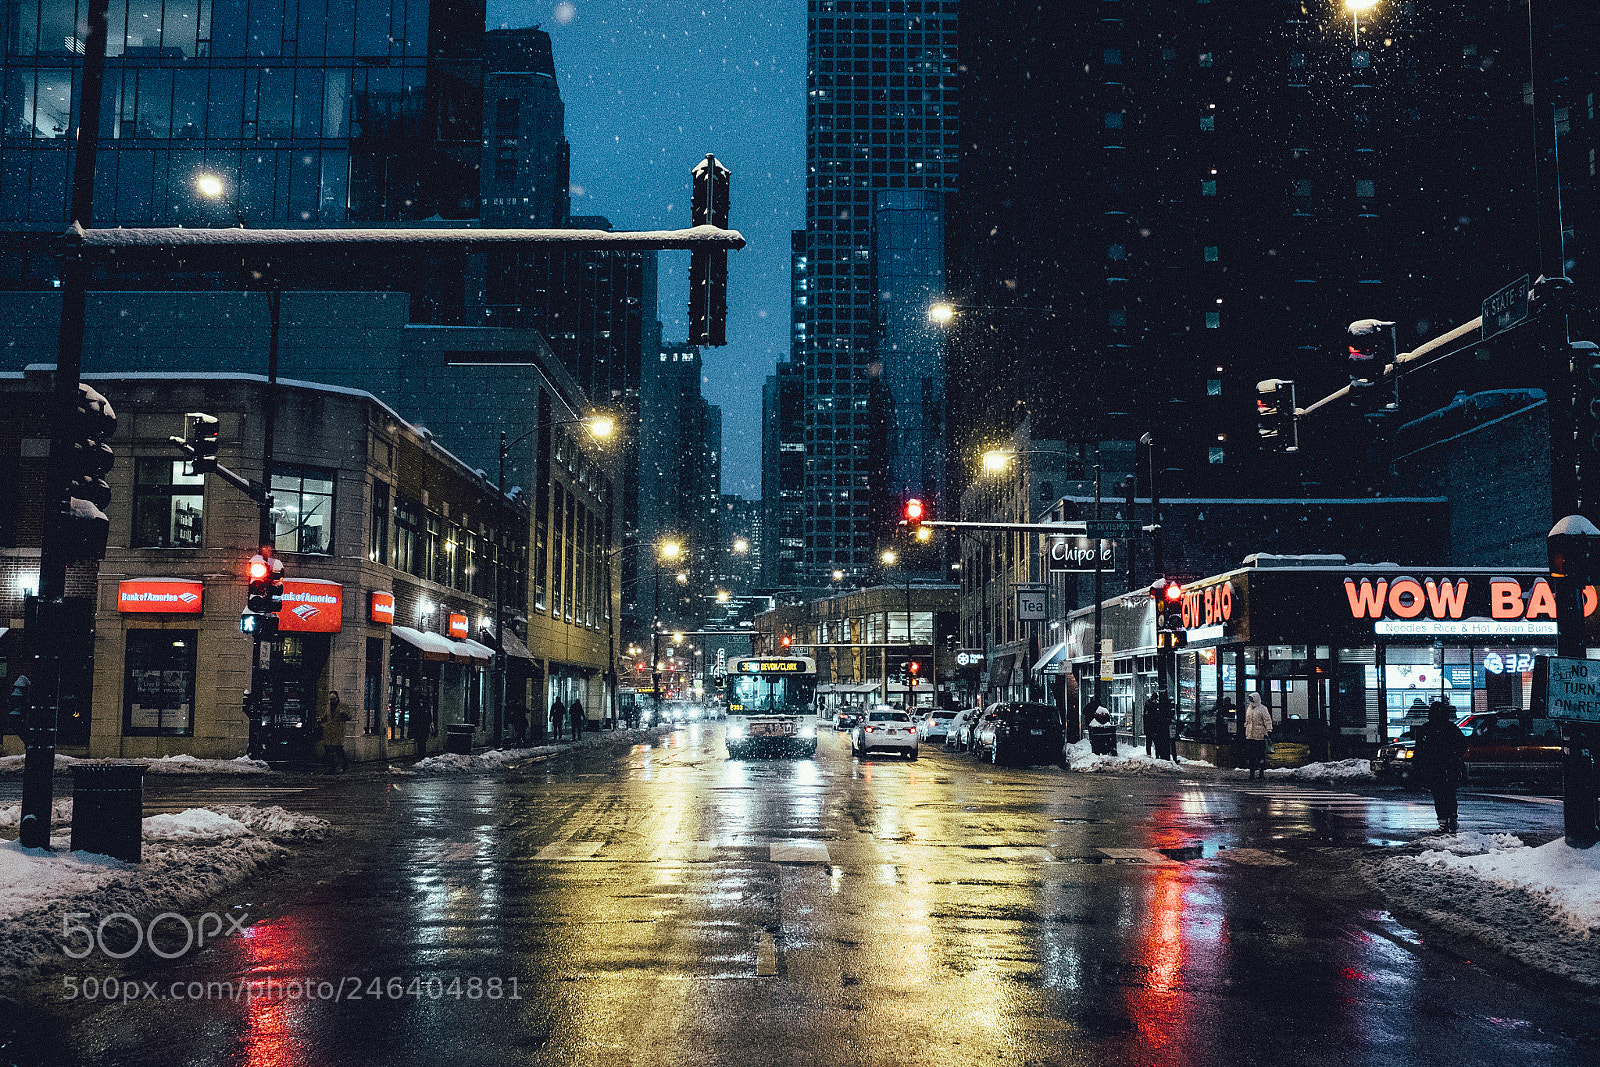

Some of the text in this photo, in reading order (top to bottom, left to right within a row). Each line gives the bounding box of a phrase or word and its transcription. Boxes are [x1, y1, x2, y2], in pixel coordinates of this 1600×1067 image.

[1491, 288, 1515, 316] STATE
[1518, 284, 1526, 297] ST
[1096, 522, 1130, 531] DIVISION
[1051, 541, 1112, 566] Chipole
[121, 592, 178, 602] Bank of America
[295, 592, 306, 602] of
[305, 593, 337, 604] America
[1344, 581, 1469, 619] WOW
[1022, 599, 1043, 612] Tea
[1181, 581, 1232, 628] OW BAO
[1434, 623, 1457, 633] Rice
[1462, 624, 1469, 633] &
[1472, 623, 1491, 633] Hot
[1496, 624, 1525, 633] Asian
[1528, 623, 1554, 633] Buns
[760, 662, 798, 671] DEVON/CLARK
[1571, 664, 1588, 678] NO
[1563, 681, 1596, 696] TURN
[1555, 698, 1572, 712] ON
